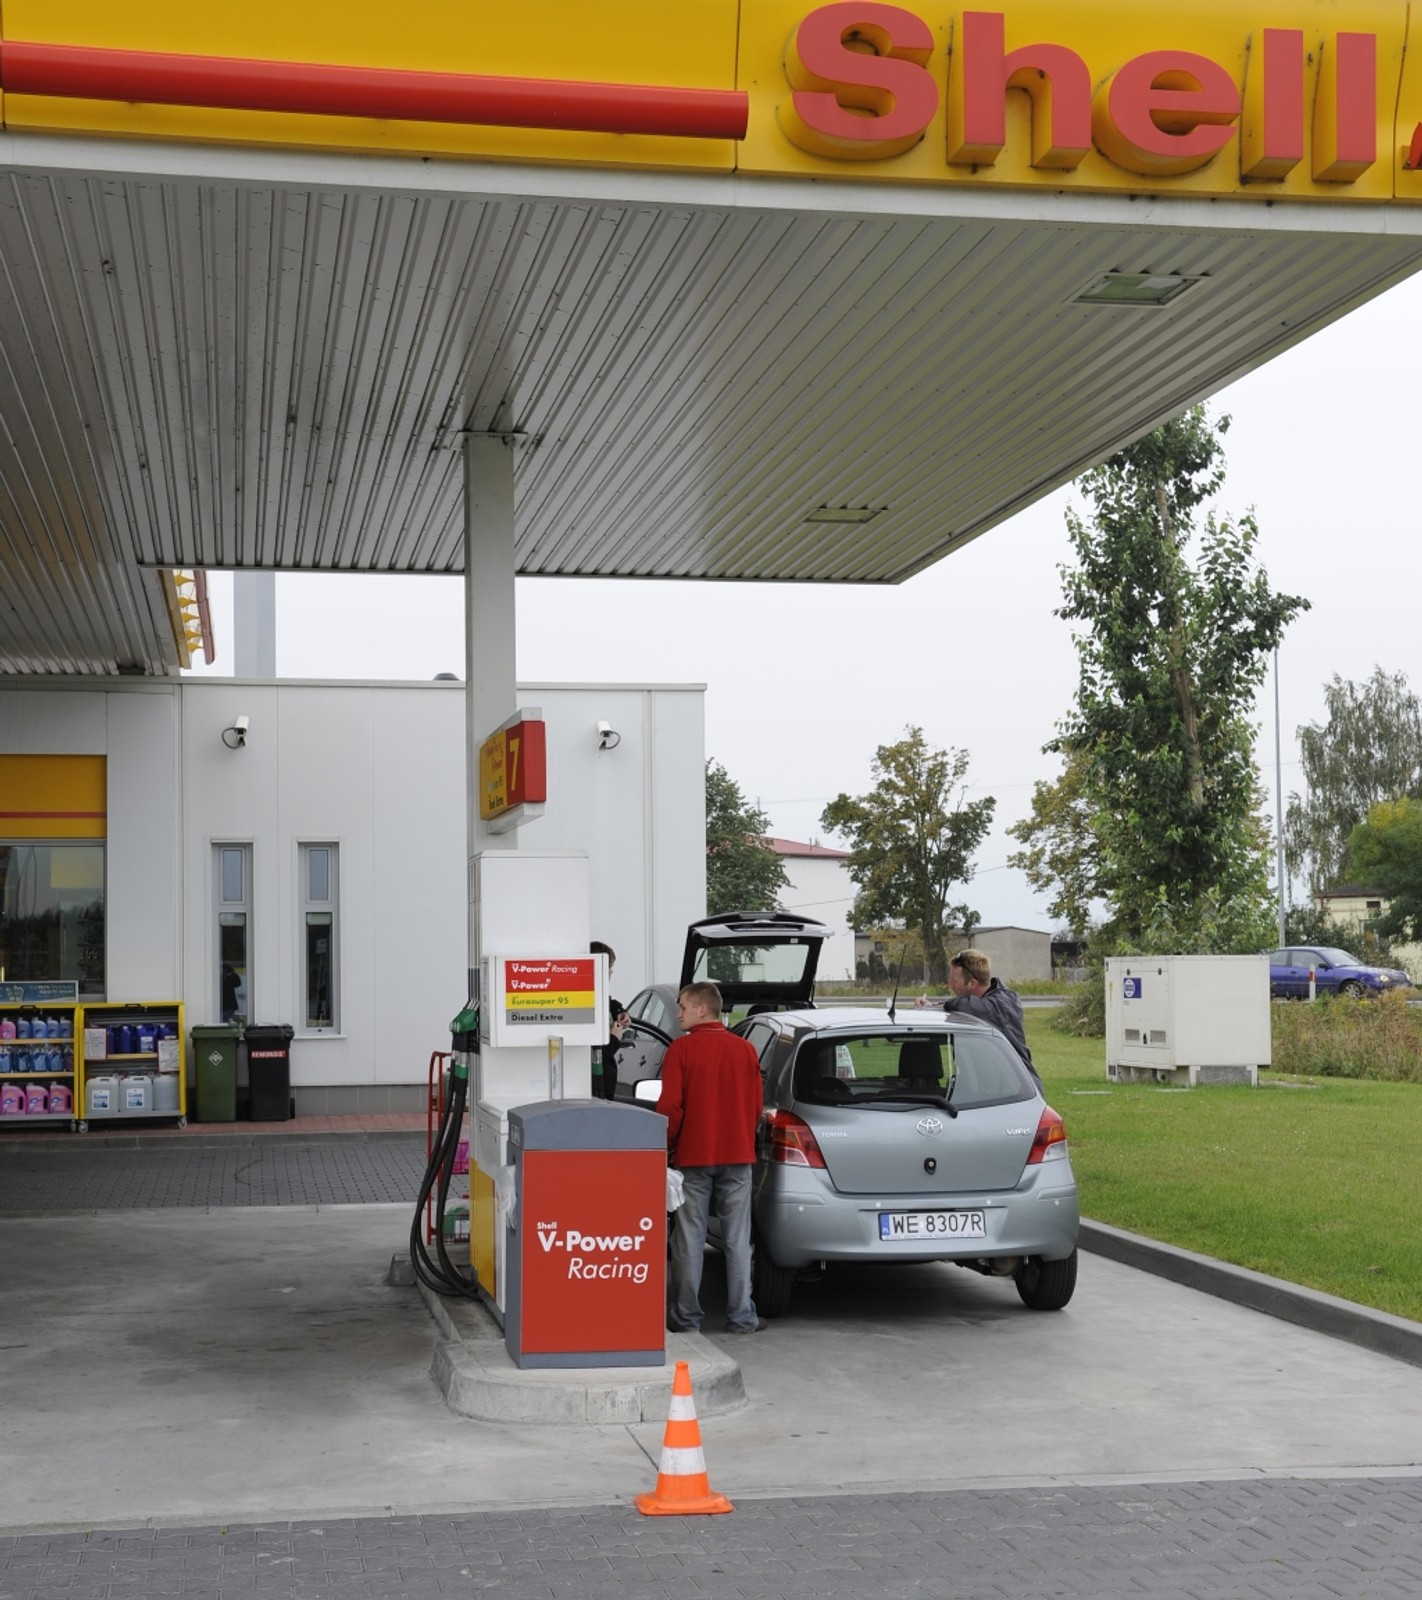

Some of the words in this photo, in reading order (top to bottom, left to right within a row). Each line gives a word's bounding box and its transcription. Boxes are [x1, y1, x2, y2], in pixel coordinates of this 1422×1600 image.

[788, 1, 1377, 169] Shell
[509, 737, 520, 791] 7
[511, 964, 550, 974] V-Power
[551, 964, 578, 974] Racing
[511, 981, 549, 989] V-Power
[511, 996, 555, 1006] Eurosuper
[557, 997, 569, 1005] 95
[511, 1012, 538, 1022] Diesel
[540, 1013, 564, 1021] Extra
[536, 1221, 557, 1230] Shell
[892, 1215, 919, 1234] WE
[925, 1213, 983, 1233] 8307R
[537, 1230, 646, 1252] V-Power
[567, 1256, 649, 1284] Racing
